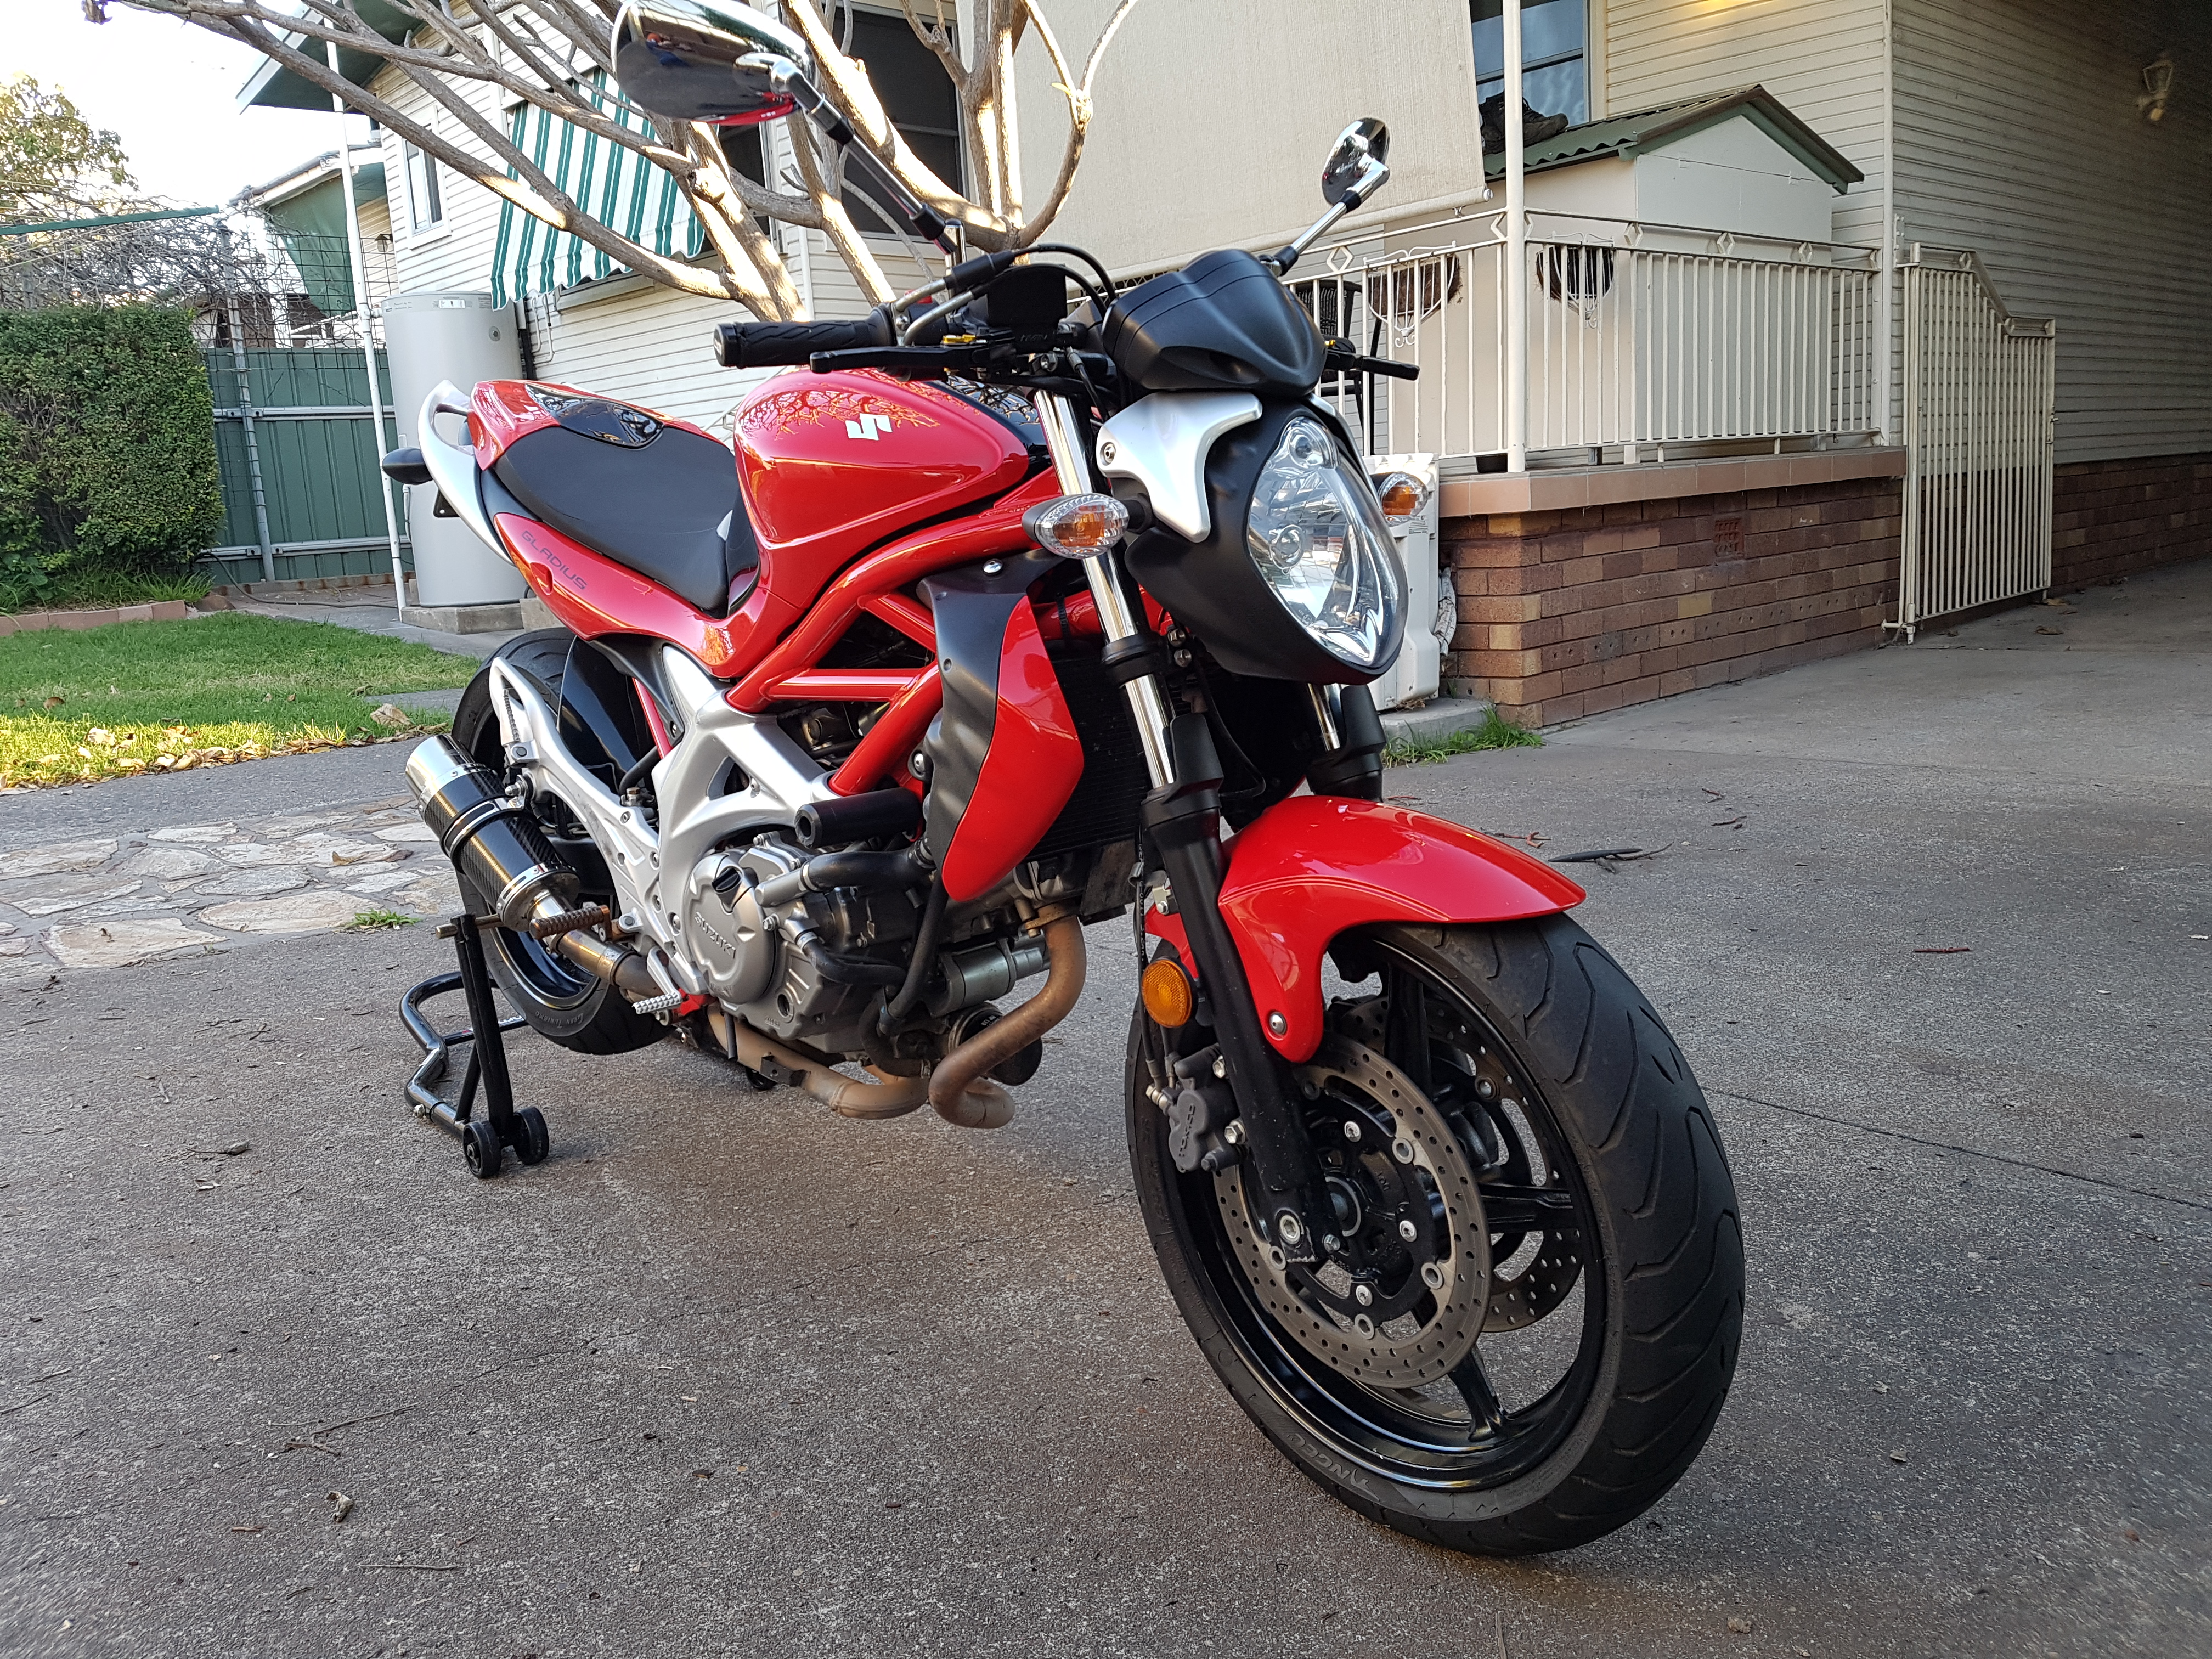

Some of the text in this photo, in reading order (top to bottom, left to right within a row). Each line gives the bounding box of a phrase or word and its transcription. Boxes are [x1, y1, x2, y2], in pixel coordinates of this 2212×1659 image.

[522, 531, 587, 590] GLADIUS
[695, 911, 736, 959] SUZUKI
[1289, 1433, 1380, 1502] ANGEL
